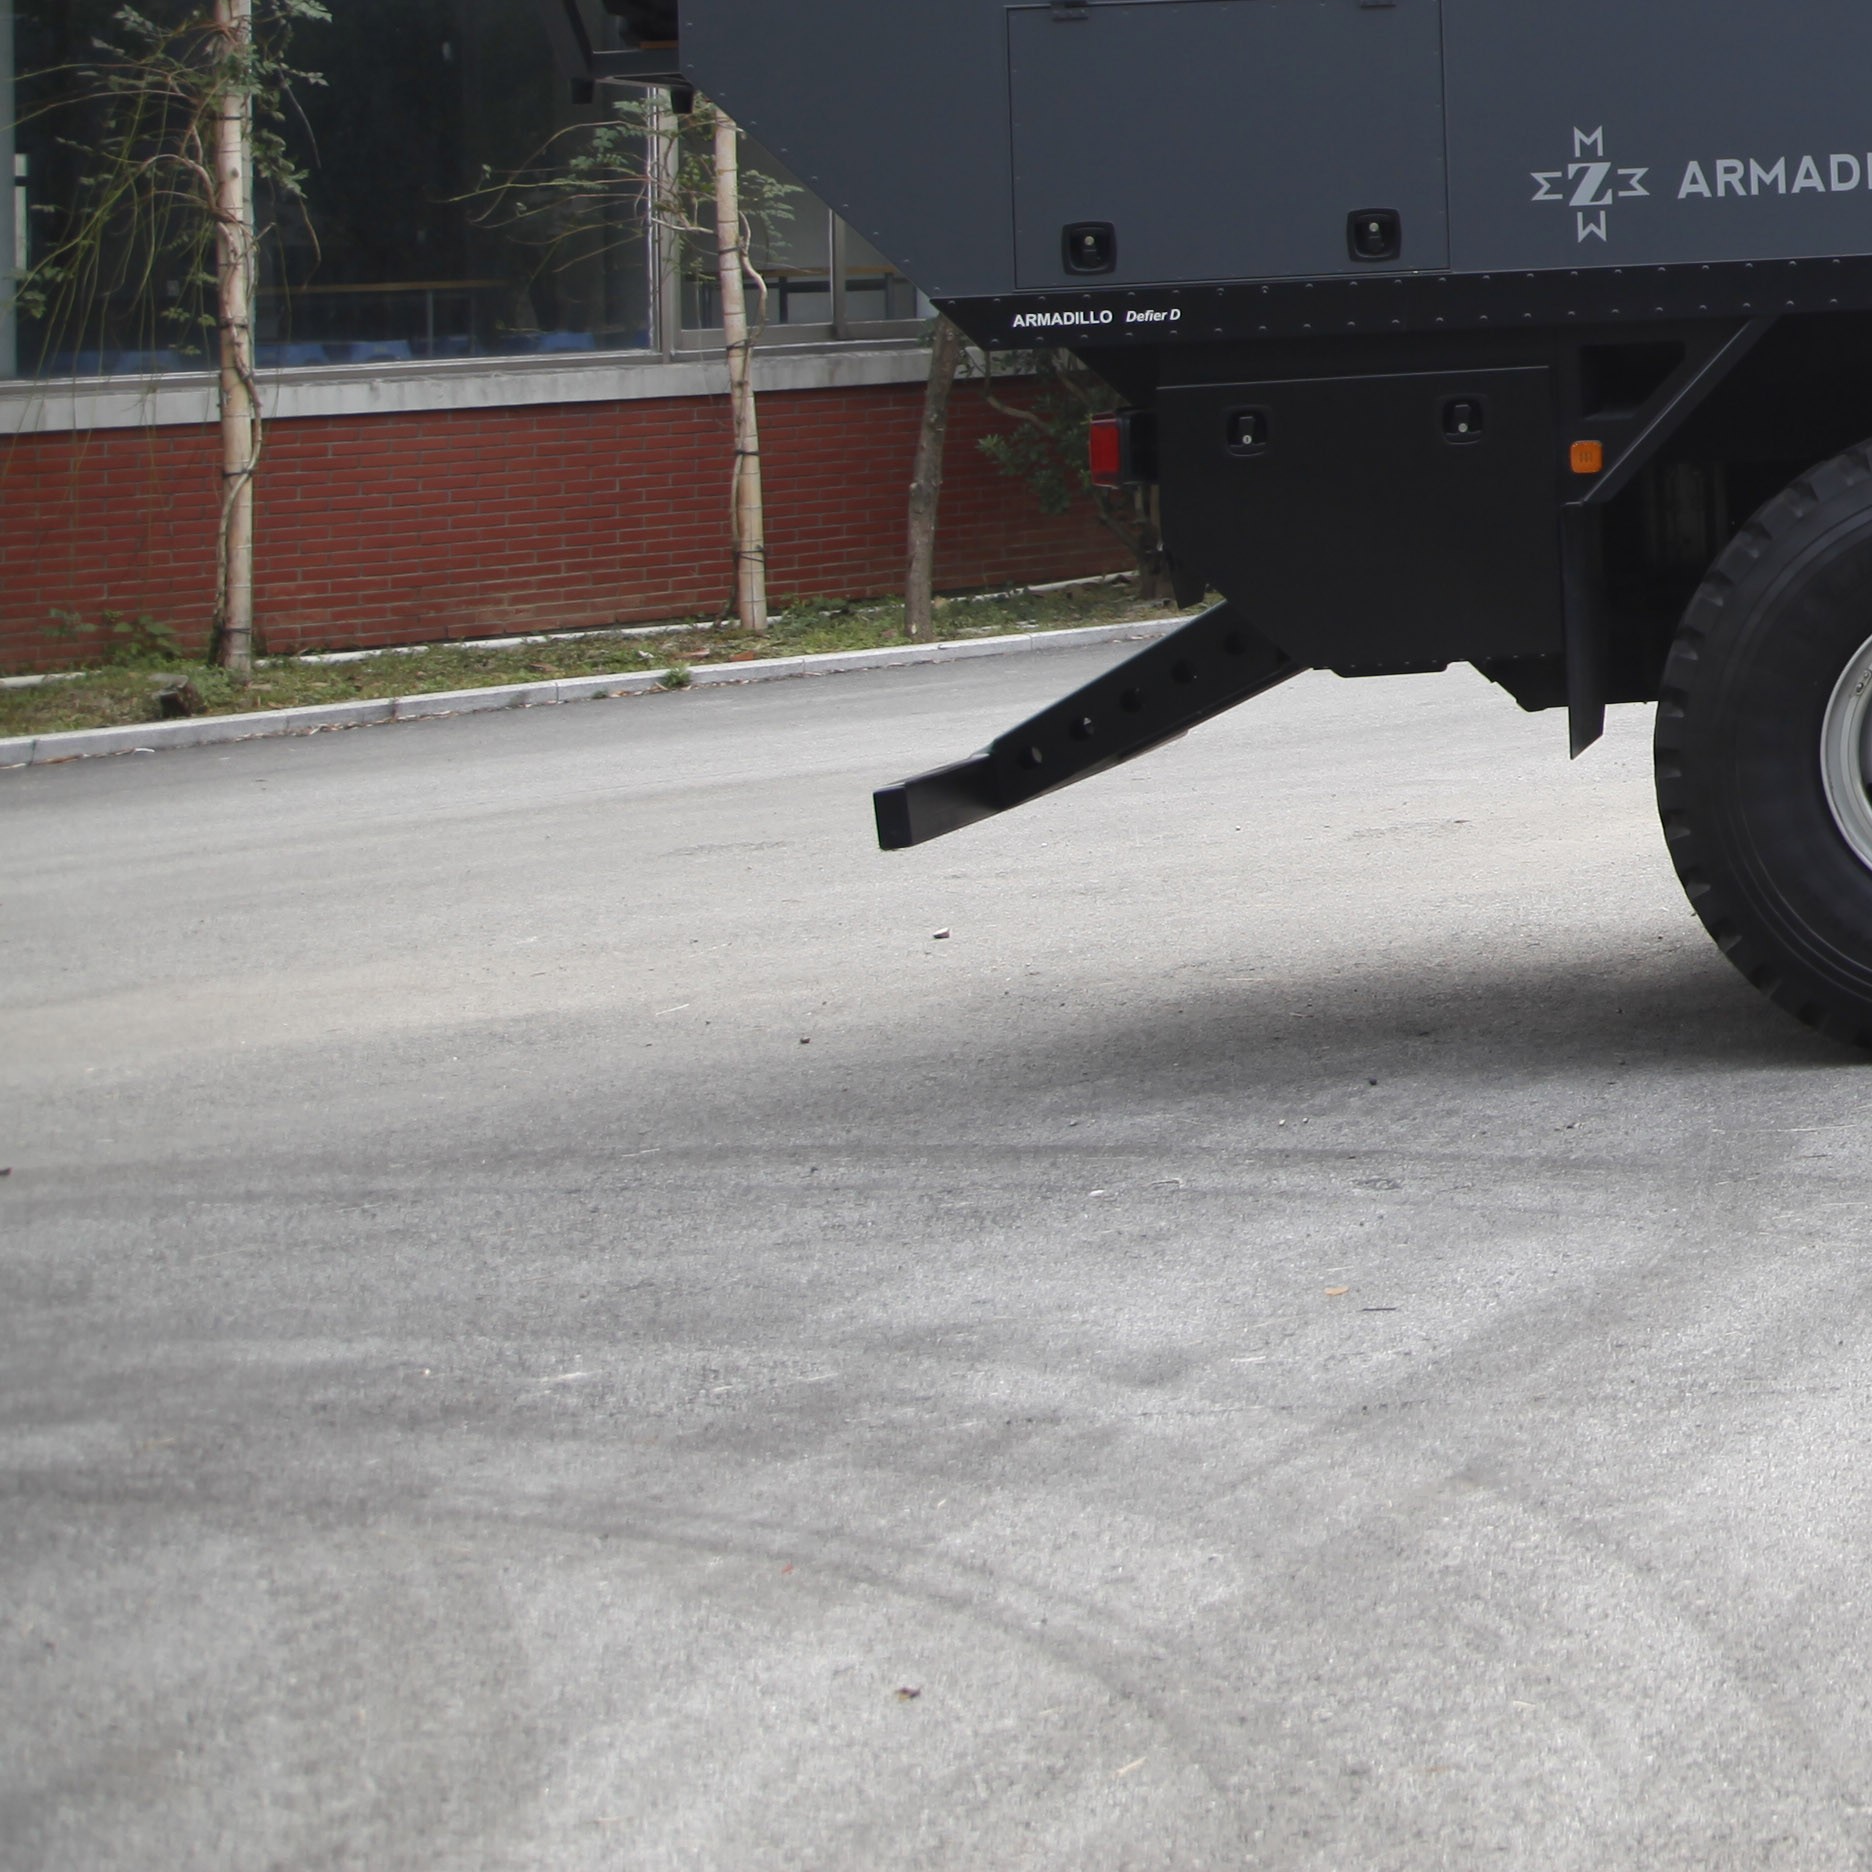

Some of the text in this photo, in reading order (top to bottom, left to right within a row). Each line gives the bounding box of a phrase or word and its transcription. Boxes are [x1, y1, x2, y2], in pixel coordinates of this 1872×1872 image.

[1012, 308, 1182, 328] ARMADILLO Defier D
